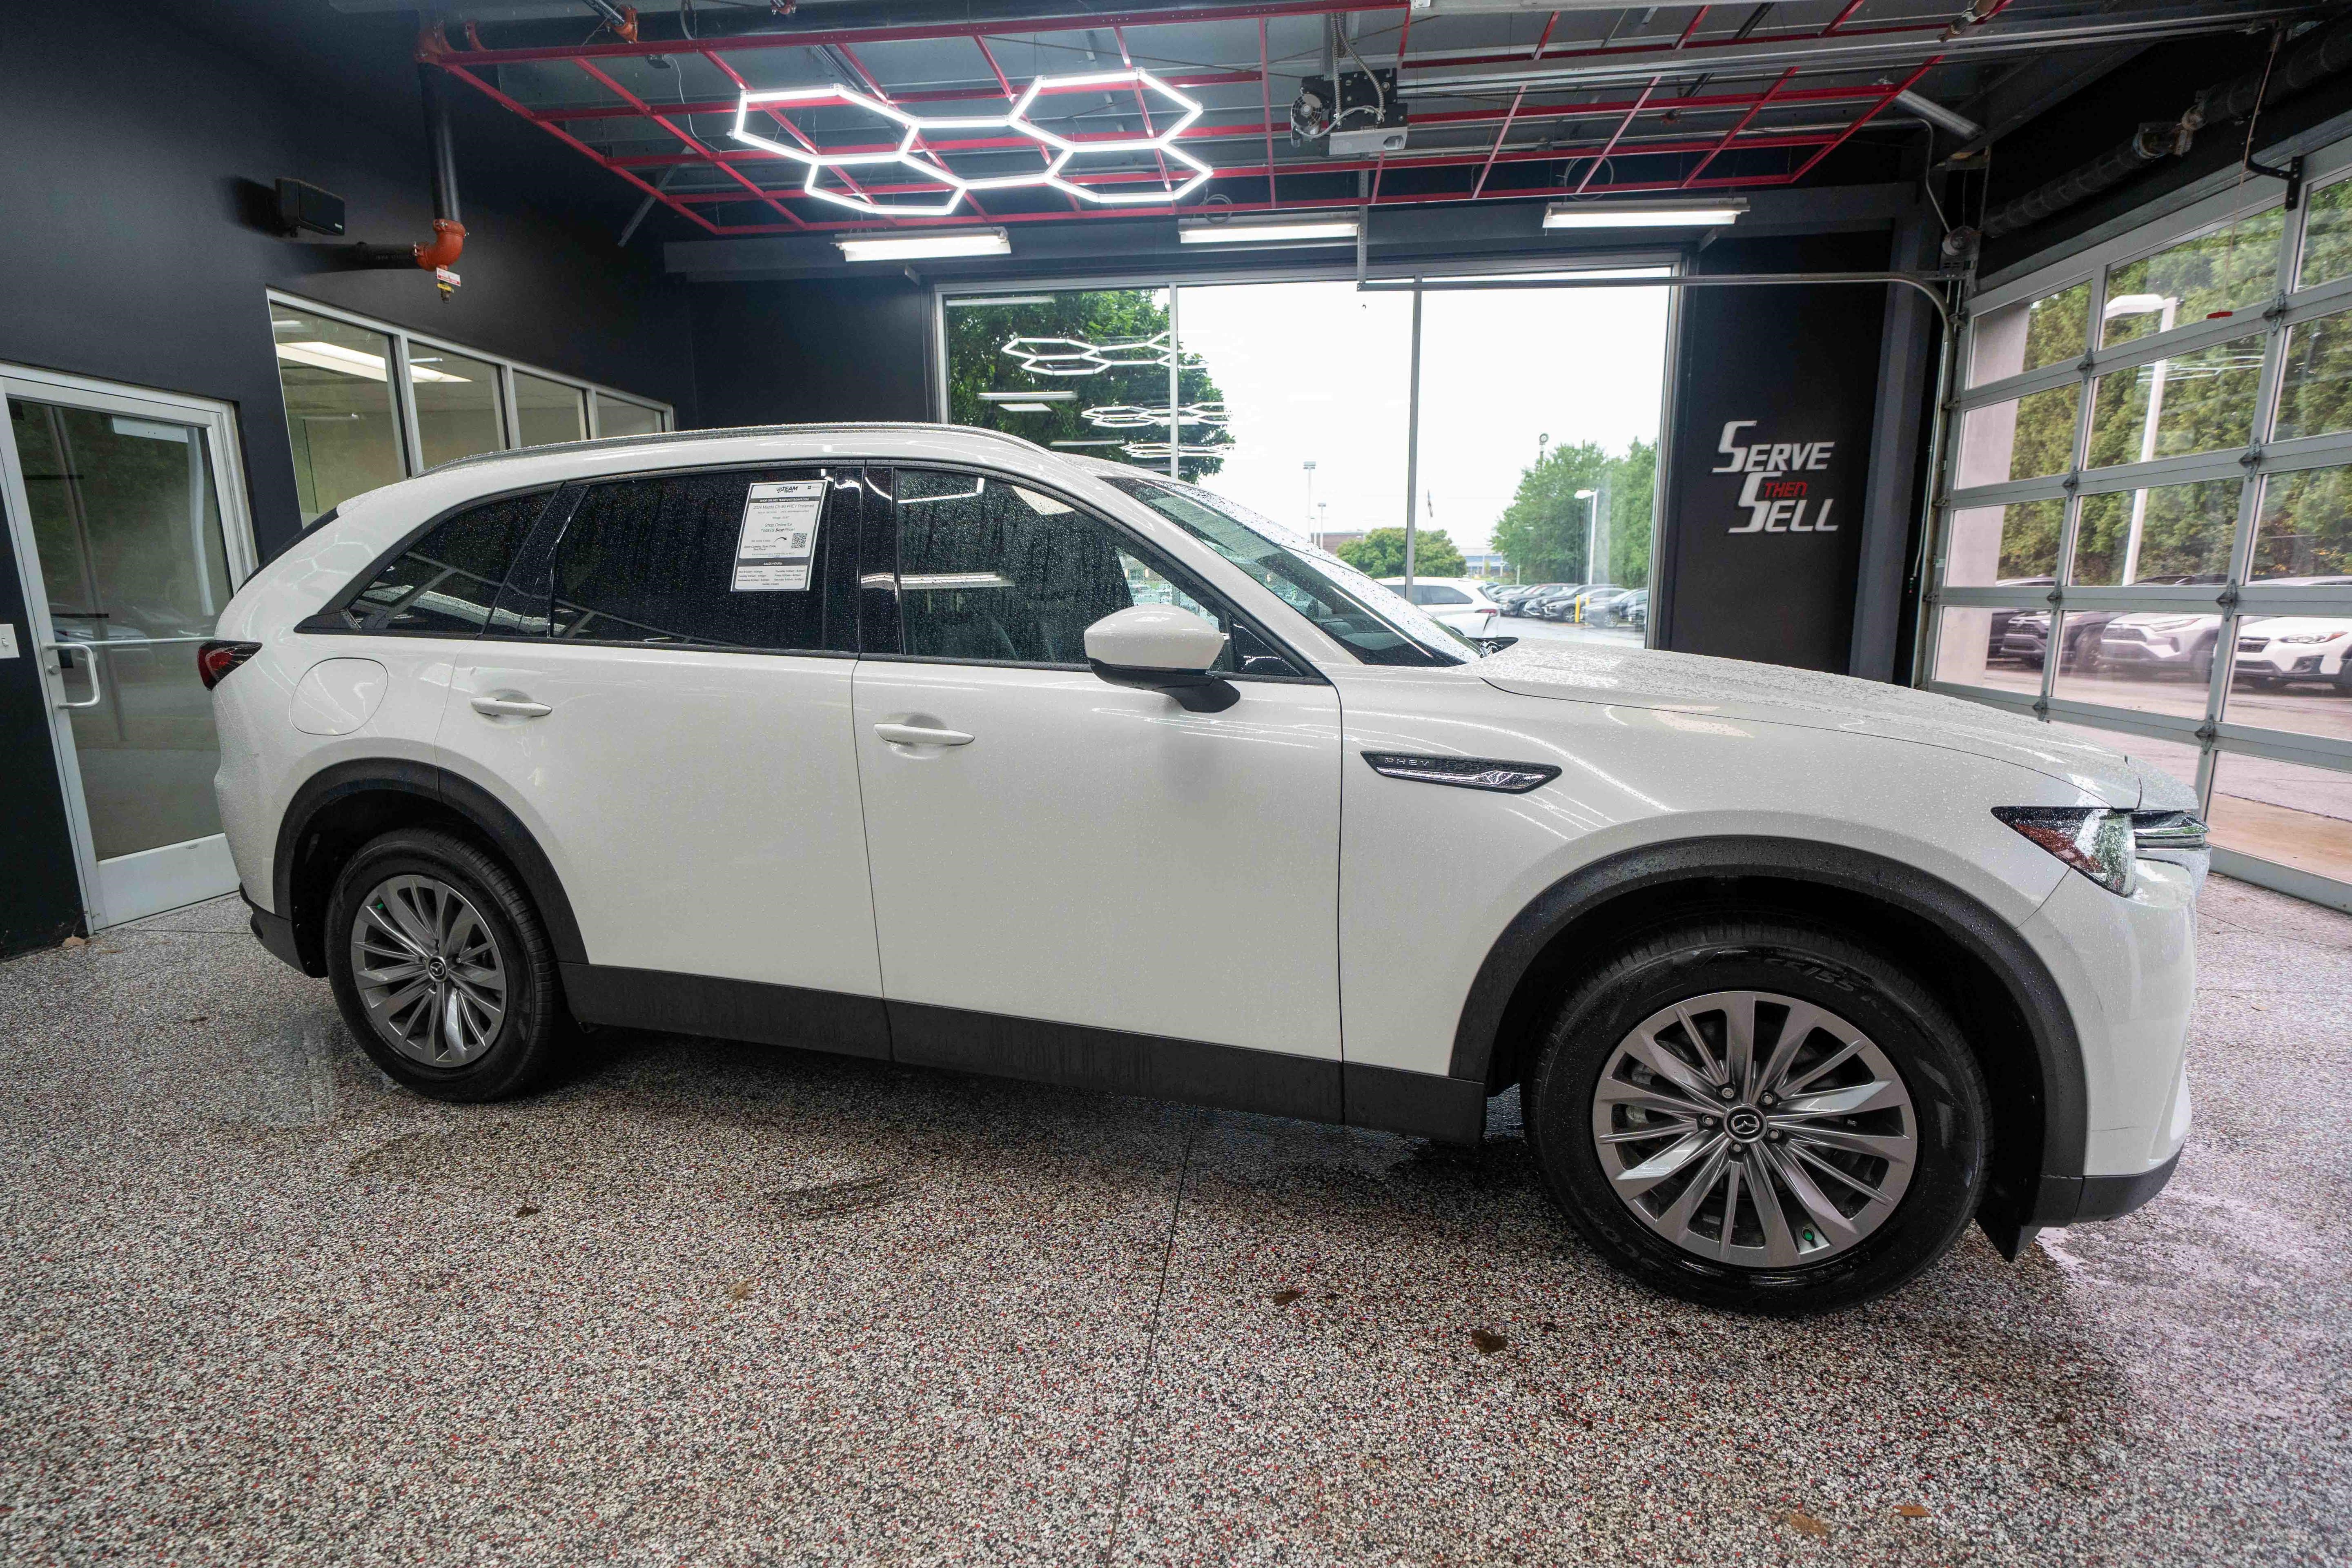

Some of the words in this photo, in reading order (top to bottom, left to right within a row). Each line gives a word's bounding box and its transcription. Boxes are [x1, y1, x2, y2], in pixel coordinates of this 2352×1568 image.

[1712, 420, 1835, 473] SERVE
[1728, 471, 1839, 533] SELL
[1764, 481, 1808, 498] THEN
[1385, 758, 1429, 766] PHEV
